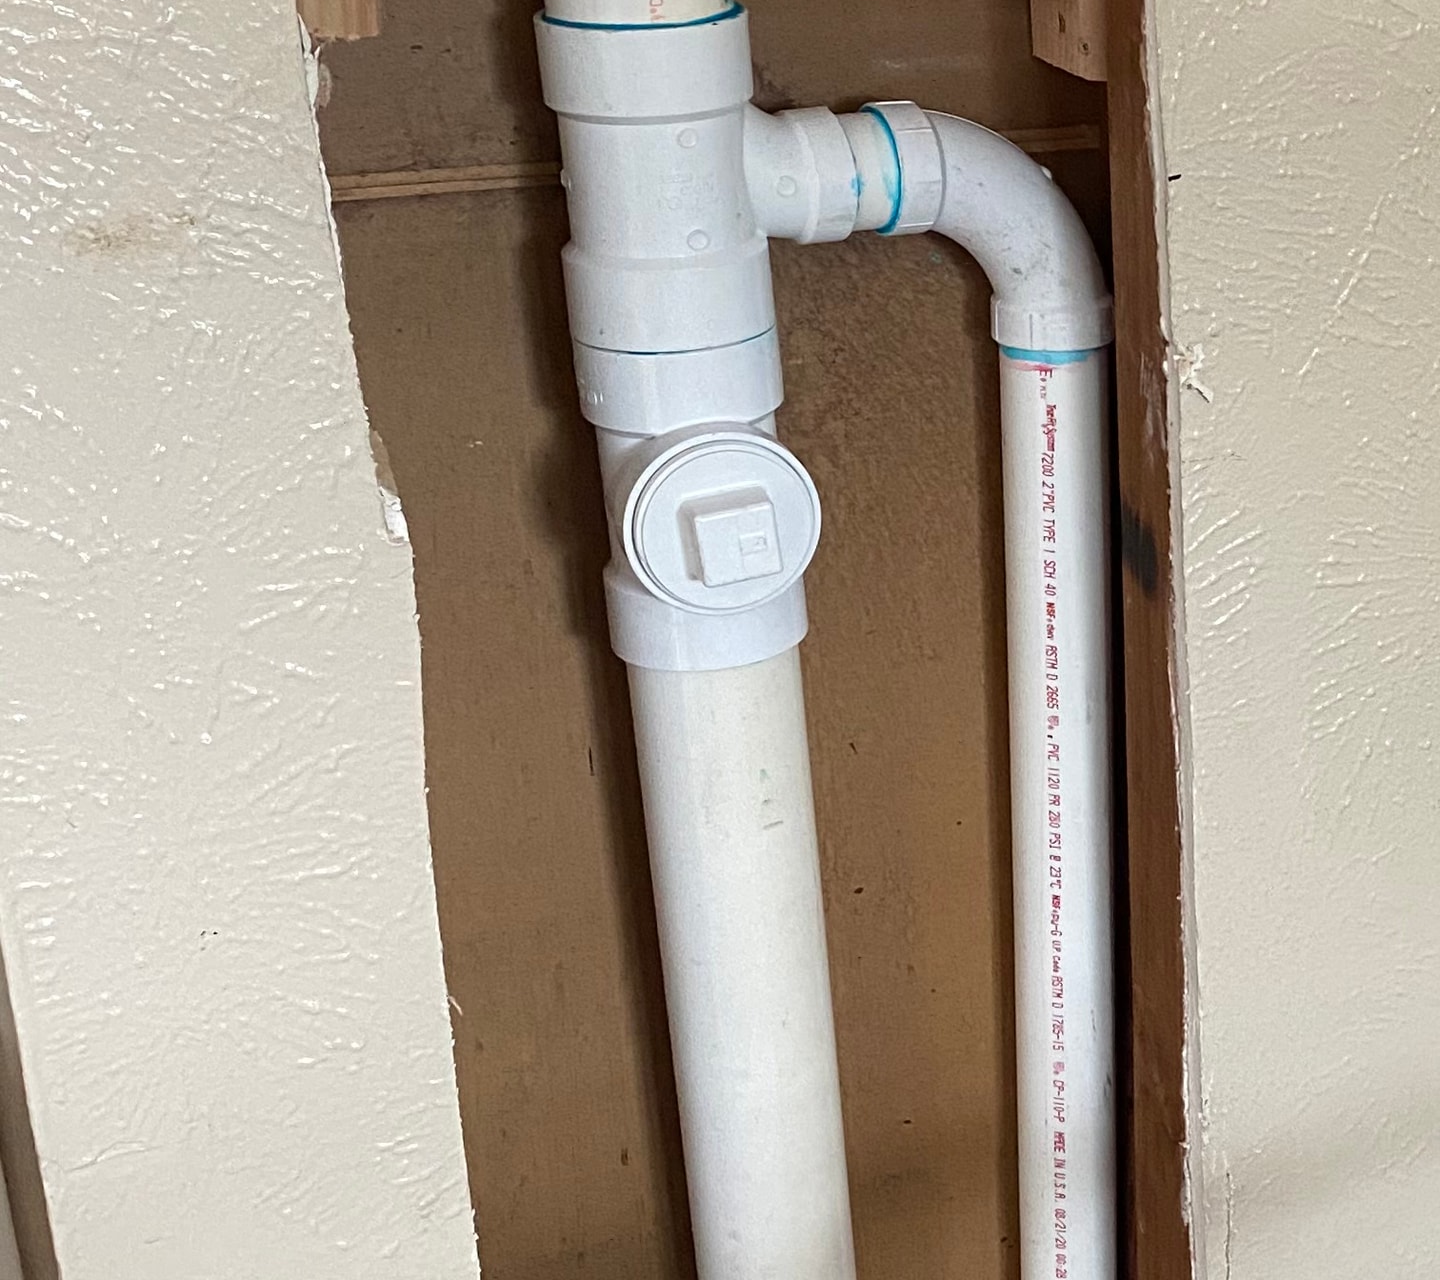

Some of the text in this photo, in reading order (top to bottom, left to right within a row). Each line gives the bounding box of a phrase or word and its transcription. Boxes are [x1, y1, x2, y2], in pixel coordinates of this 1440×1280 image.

[1042, 452, 1053, 476] 7200
[1043, 519, 1054, 543] TYPE
[1043, 560, 1055, 578] SCH
[1044, 583, 1055, 595] 40
[1045, 645, 1056, 669] ASTM
[1046, 685, 1057, 709] 2665
[1047, 743, 1059, 760] PVC
[1047, 767, 1059, 789] 1120
[1048, 793, 1059, 806] PR
[1048, 832, 1060, 850] PSI
[1051, 975, 1062, 998] ASTM
[1052, 1014, 1063, 1051] 1785-15
[1053, 1079, 1064, 1122] CP-110-P
[1054, 1130, 1065, 1153] MADE
[1054, 1157, 1065, 1168] IN
